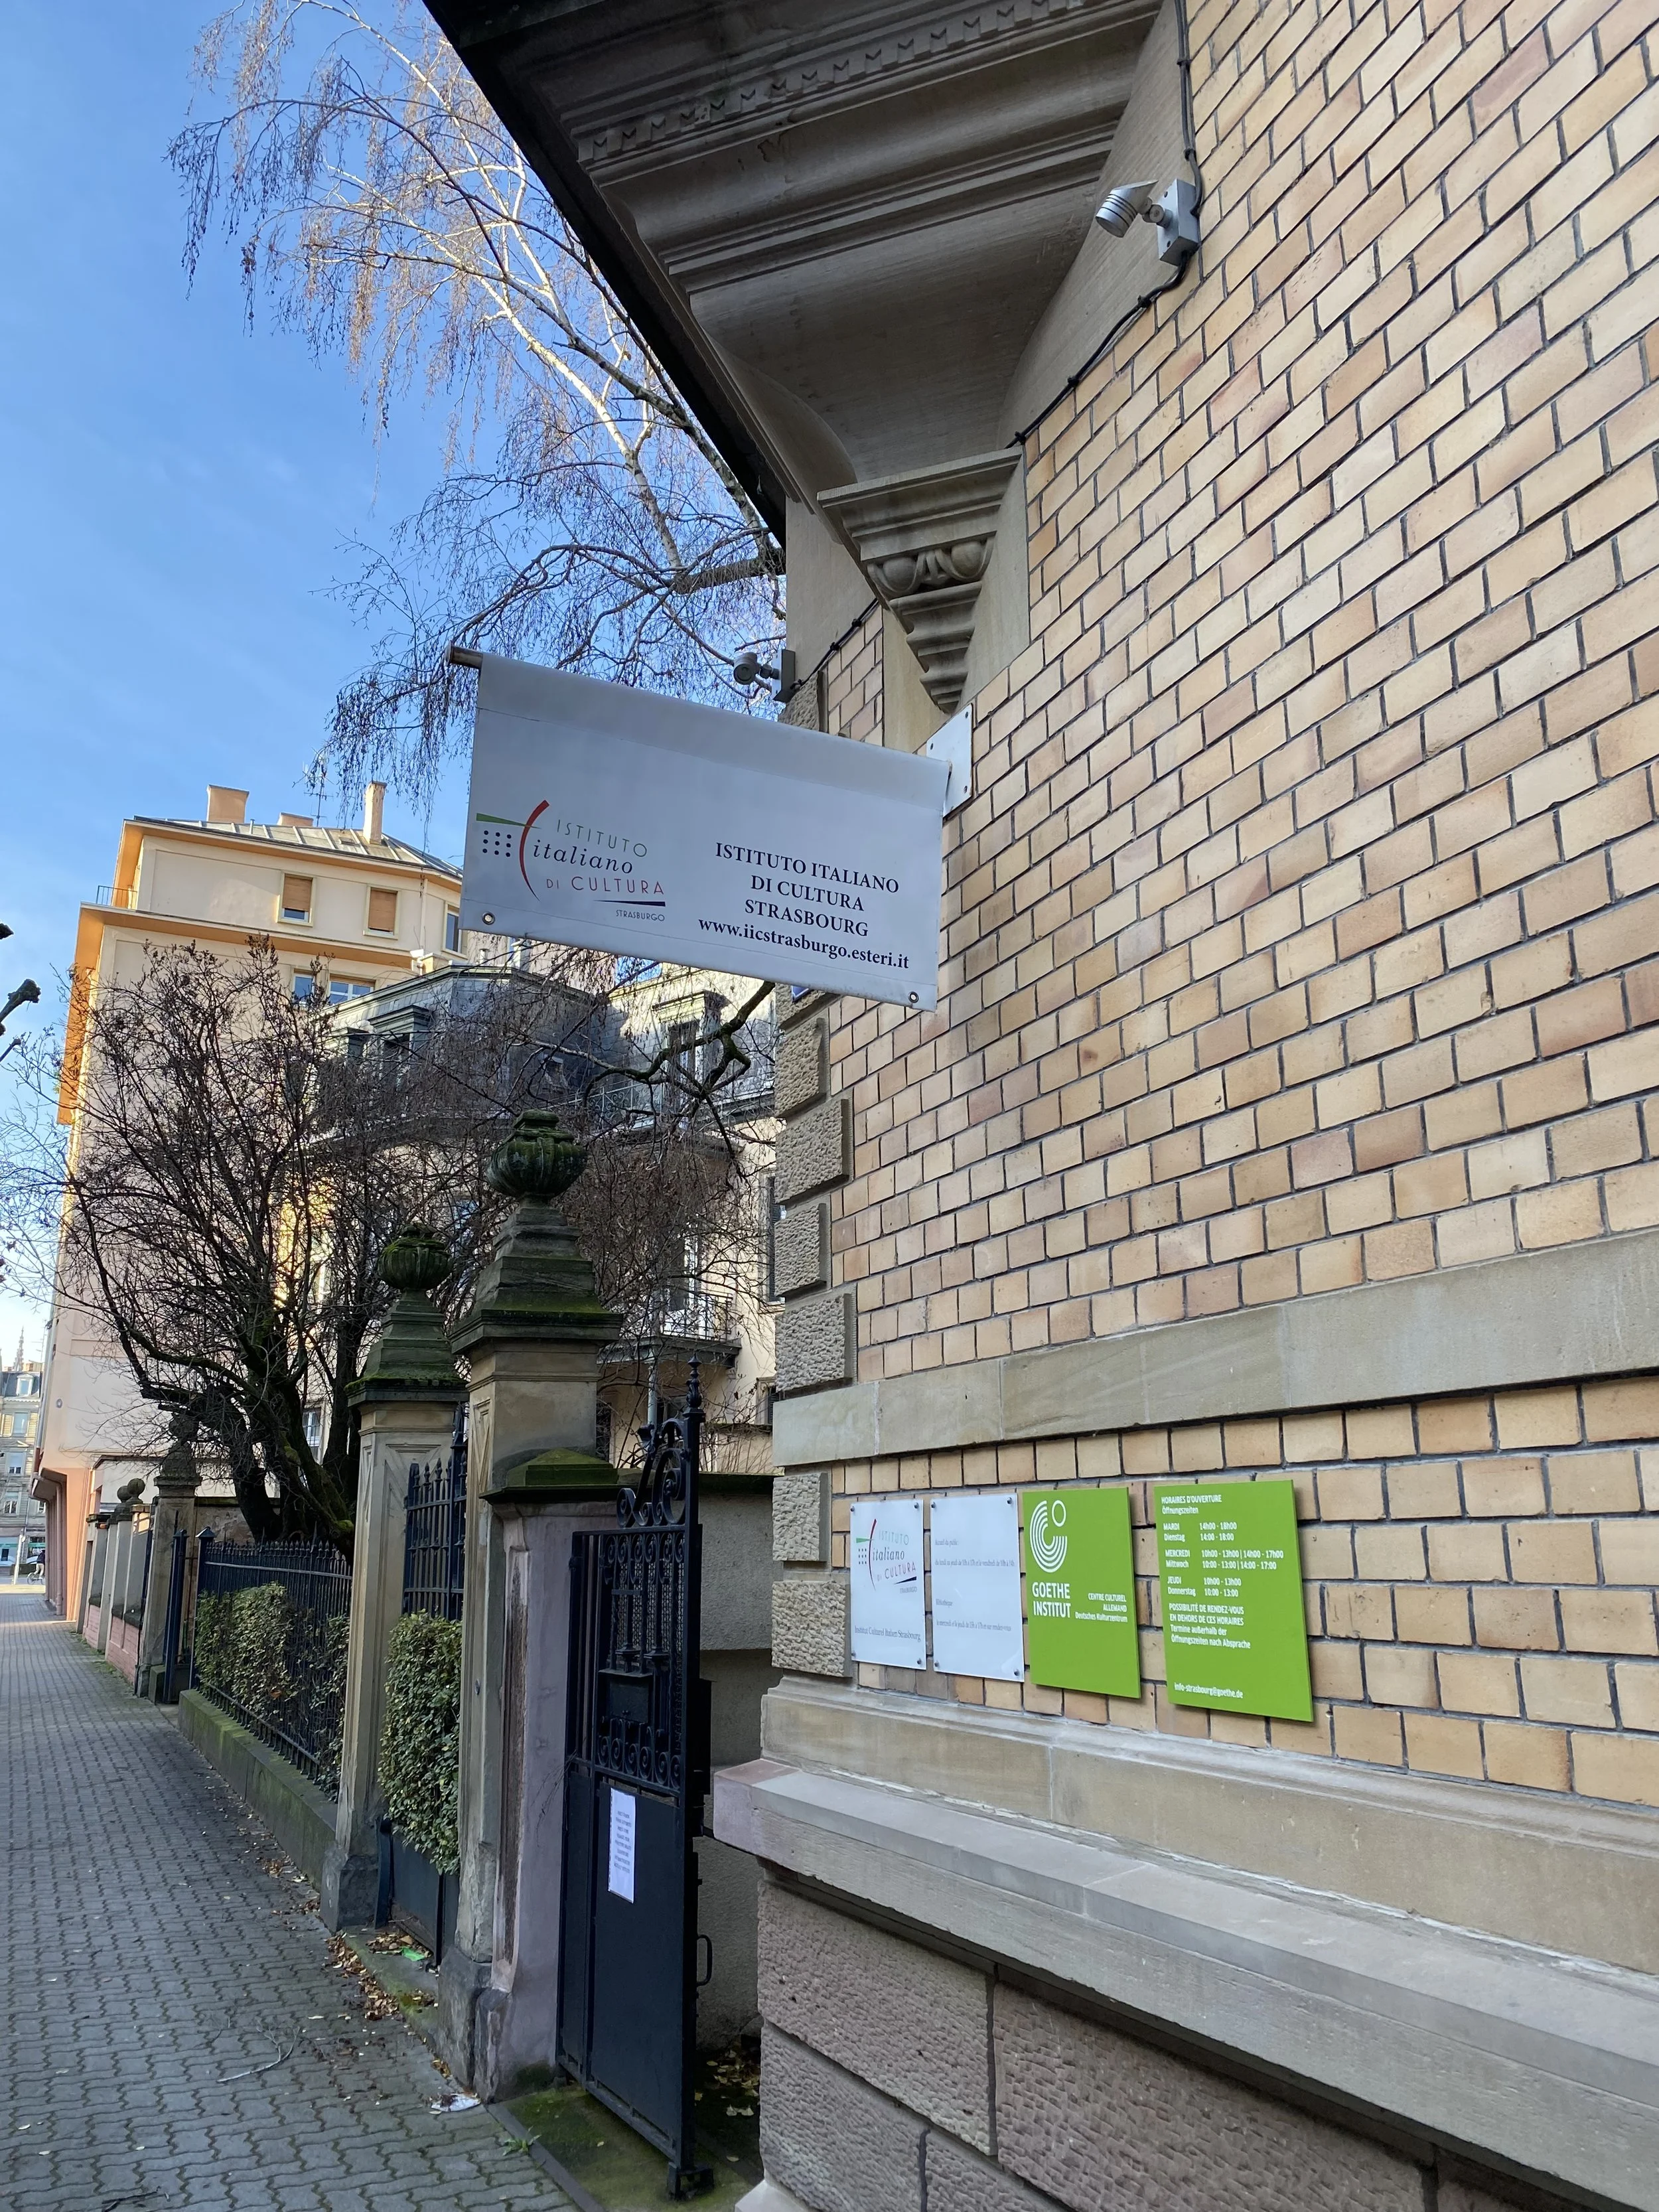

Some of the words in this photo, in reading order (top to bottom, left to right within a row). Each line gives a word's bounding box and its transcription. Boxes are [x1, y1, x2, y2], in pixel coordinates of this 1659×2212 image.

[556, 819, 648, 857] ISTITUTO
[534, 839, 633, 874] italiano
[715, 842, 806, 874] ISTITUTO
[811, 862, 899, 893] ITALIANO
[546, 878, 559, 889] DI
[571, 875, 664, 895] CULTURA
[751, 875, 772, 893] DI
[777, 881, 864, 911] CULTURA
[616, 909, 665, 922] STRASBURGO
[745, 899, 868, 936] STRASBOURG
[698, 919, 910, 969] www.iicstrasburgo.esteri.it
[1187, 1495, 1222, 1503] D'OUVERTURE
[1162, 1506, 1198, 1515] Öffnungszeiten
[879, 1530, 909, 1545] ISTITUTO
[1164, 1533, 1185, 1542] Dienstag
[873, 1547, 905, 1561] italiano
[1244, 1550, 1261, 1558] 14h00
[1265, 1550, 1283, 1558] 17h00
[885, 1562, 916, 1579] CULTURA
[1224, 1578, 1242, 1586] 13h00
[1032, 1582, 1070, 1599] GOETHE
[1167, 1587, 1196, 1597] Donnerstag
[1033, 1601, 1071, 1618] INSTITUT
[1103, 1603, 1127, 1612] ALLEMAND
[1169, 1603, 1198, 1612] POSSIBILITÉ
[1207, 1605, 1244, 1615] RENDEZ-VOUS
[1075, 1611, 1096, 1620] Deutsches
[1096, 1613, 1127, 1623] Kulturzentrum
[1178, 1614, 1198, 1623] DEHORS
[1216, 1617, 1244, 1626] HORAIRES
[898, 1630, 921, 1642] Strasbourg
[1171, 1624, 1190, 1633] Termine
[1192, 1626, 1217, 1635] außerhalb
[1218, 1627, 1227, 1636] der
[1171, 1634, 1208, 1645] Öffnungszeiten
[1209, 1638, 1222, 1647] nach
[1222, 1639, 1250, 1649] Absprache
[1175, 1682, 1243, 1698] info-strasbourg@goethe.de
